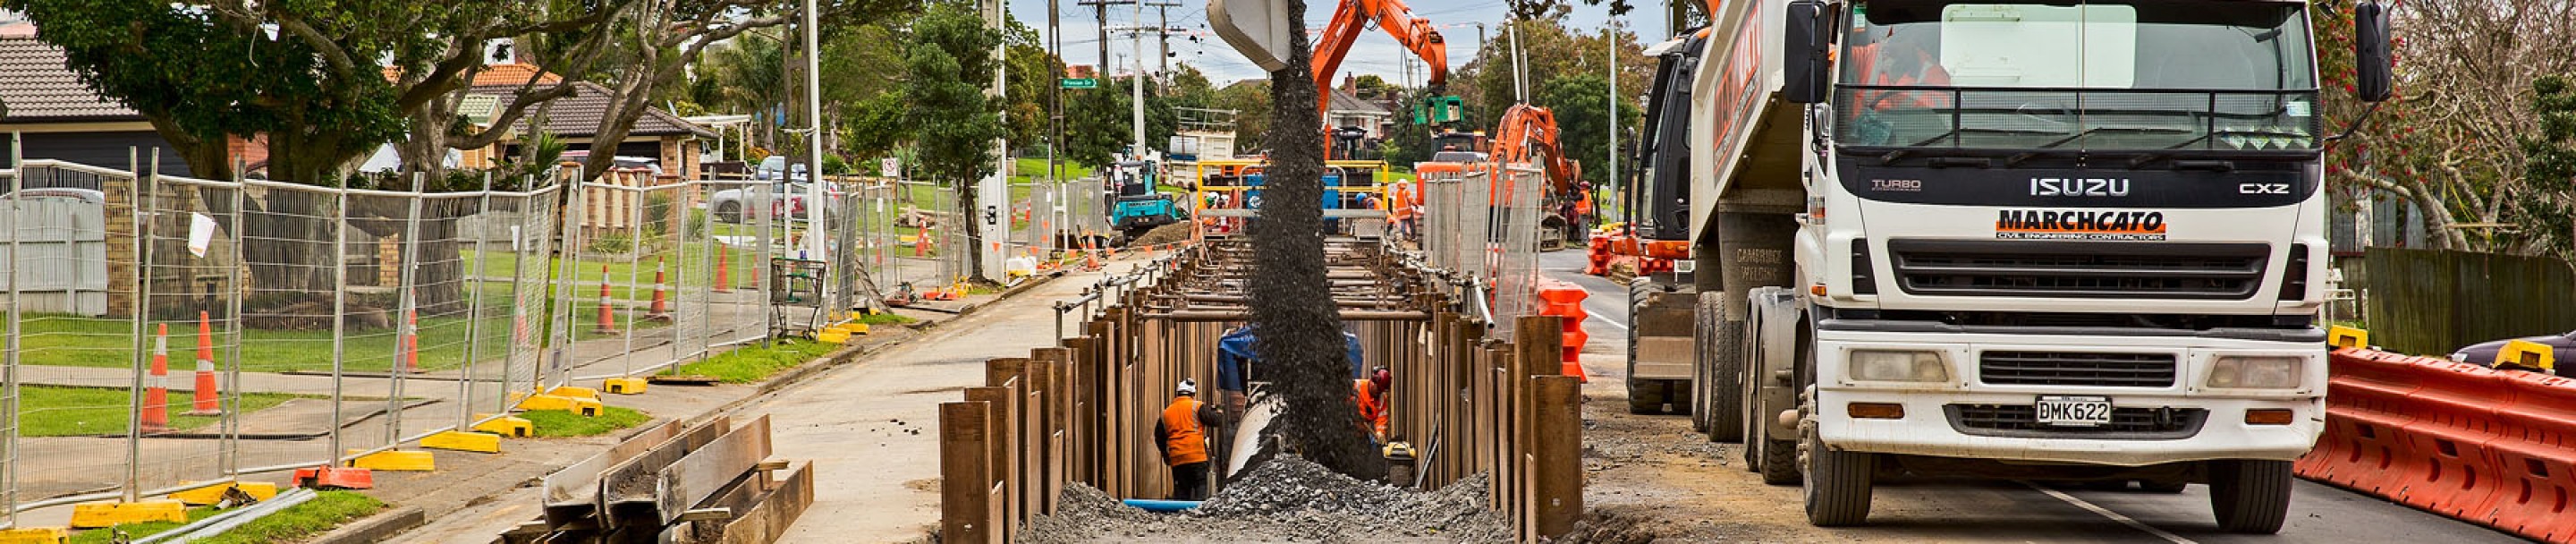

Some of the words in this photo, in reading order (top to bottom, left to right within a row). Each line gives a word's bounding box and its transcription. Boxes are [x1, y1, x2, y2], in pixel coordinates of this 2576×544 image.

[1871, 180, 1921, 188] TURBO
[2029, 178, 2130, 197] ISUZU
[2239, 183, 2290, 194] CXZ
[1999, 210, 2164, 231] MARCHCATO
[2038, 403, 2107, 421] DMK622
